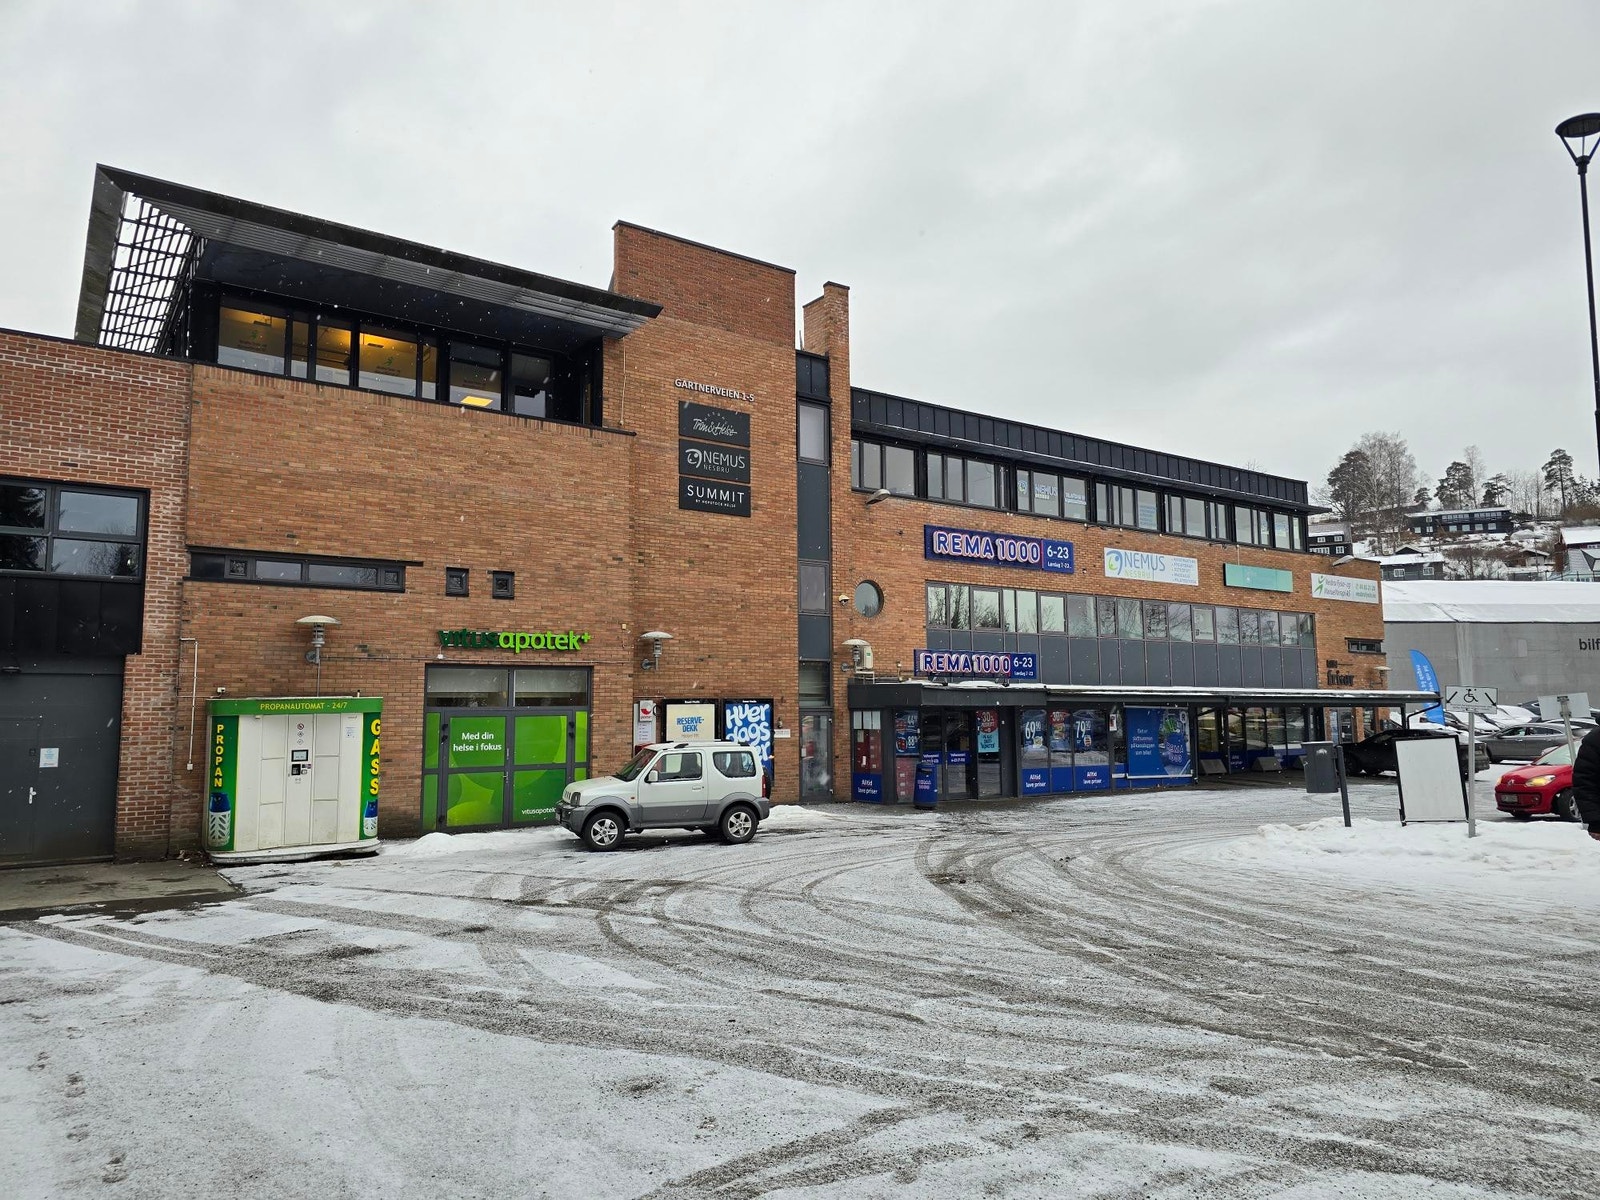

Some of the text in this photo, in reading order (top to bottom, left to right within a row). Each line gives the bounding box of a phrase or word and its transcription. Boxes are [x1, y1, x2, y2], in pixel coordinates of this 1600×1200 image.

[675, 378, 740, 399] GARTNERVEIEN
[703, 450, 746, 469] NEMUS
[703, 464, 730, 473] NESBRU
[687, 484, 745, 503] SUMMIT
[933, 531, 1041, 563] REMA 1000
[1047, 547, 1069, 559] 6-23
[1124, 551, 1166, 571] NEMUS
[920, 652, 1011, 673] REMA 1000
[1013, 657, 1033, 668] 6-23
[260, 702, 325, 710] PROPANAUTOMAT
[676, 716, 705, 725] RESERVE-
[682, 724, 698, 732] DEKK
[461, 731, 495, 740] Med din
[1025, 721, 1036, 739] 69
[1075, 721, 1086, 738] 79
[213, 724, 224, 787] PROPAN
[453, 743, 474, 752] helse
[480, 742, 502, 751] fokus
[370, 719, 381, 795] GASS
